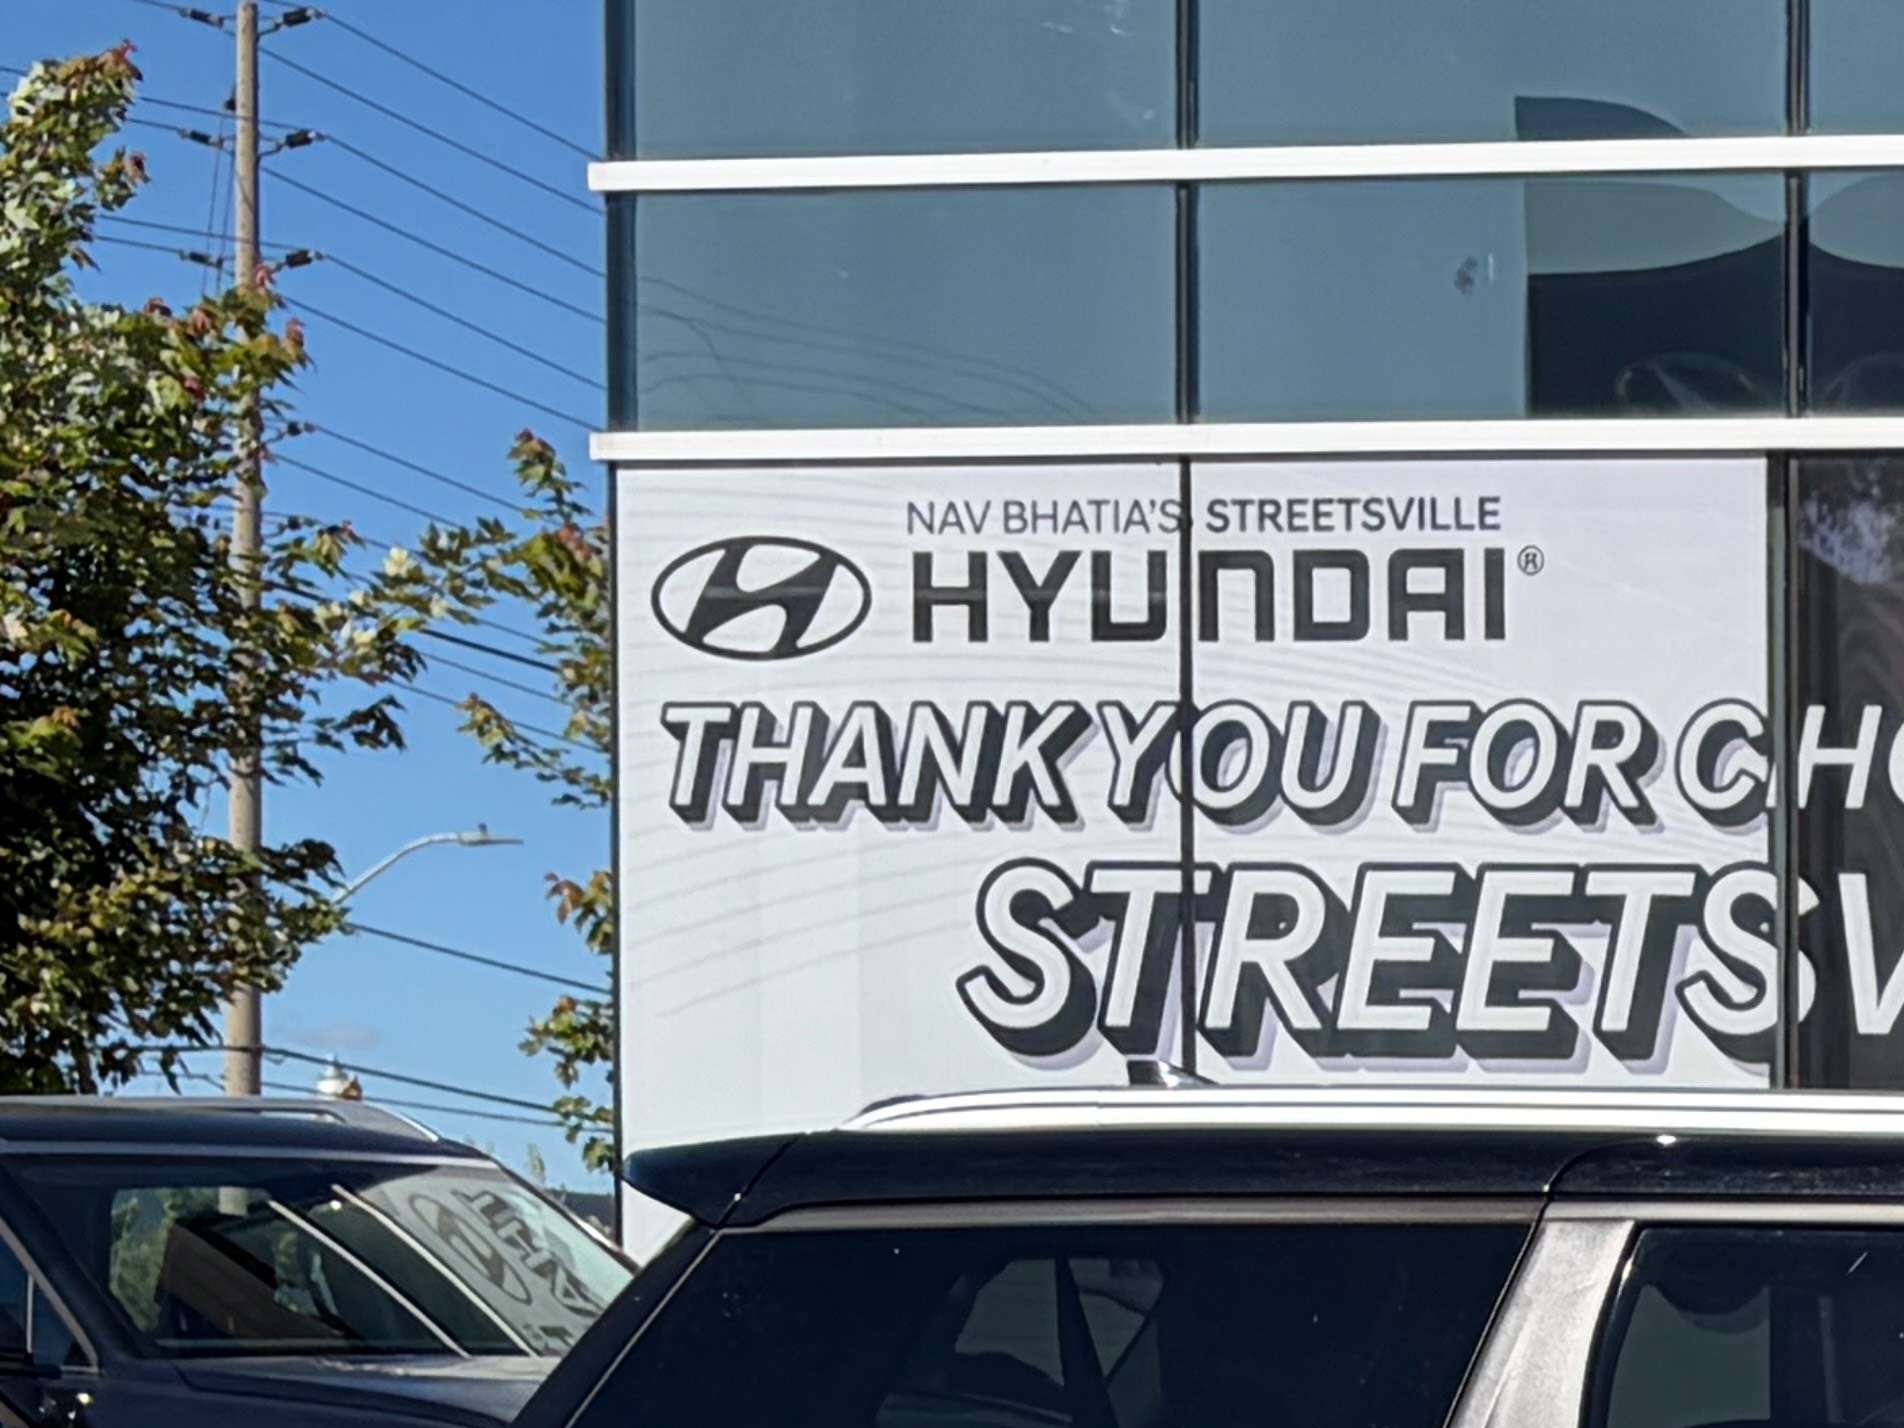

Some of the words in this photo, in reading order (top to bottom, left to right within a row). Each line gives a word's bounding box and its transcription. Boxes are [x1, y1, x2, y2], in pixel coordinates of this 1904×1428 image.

[906, 500, 991, 535] NAV
[1002, 498, 1184, 535] BHATIA'S
[1204, 495, 1502, 533] STREETSVILLE
[659, 699, 1096, 826] THANK
[1092, 699, 1390, 827] YOU
[1392, 699, 1663, 827] FOR
